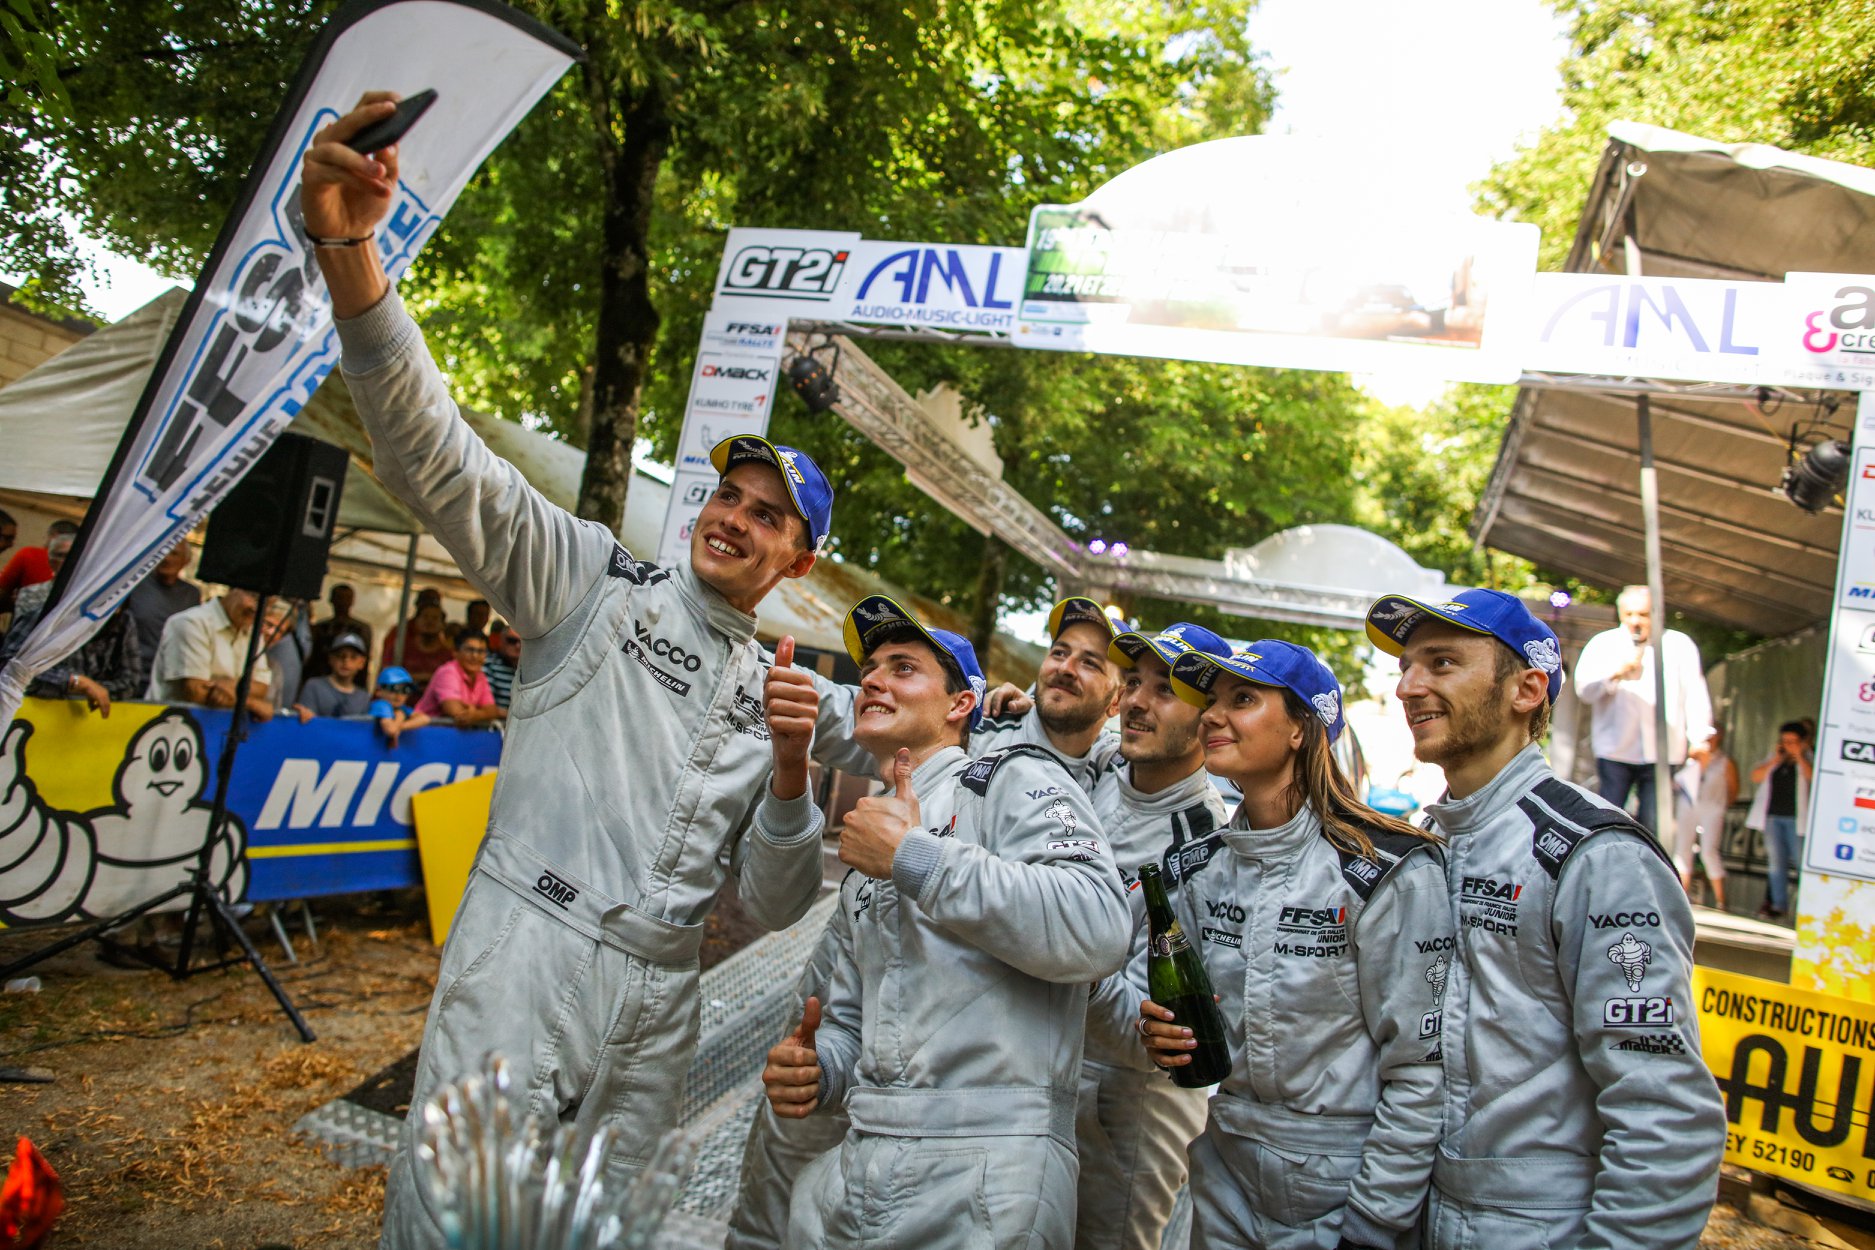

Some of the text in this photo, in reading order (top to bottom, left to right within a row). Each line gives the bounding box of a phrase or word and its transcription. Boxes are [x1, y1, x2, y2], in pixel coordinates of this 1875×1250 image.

[856, 248, 1013, 309] AML
[851, 304, 1014, 328] AUDIO-MUSIC-LIGHT
[1539, 283, 1759, 355] AML
[635, 619, 701, 672] YACCO
[641, 656, 686, 692] MICHELIN
[967, 763, 992, 779] OMP
[1539, 832, 1568, 857] OMP
[1181, 847, 1209, 869] OMP
[1348, 858, 1379, 881] OMP
[537, 874, 576, 904] OMP
[1461, 876, 1513, 902] FFSA
[1278, 907, 1338, 926] FFSA
[1461, 915, 1518, 937] M-SPORT
[1485, 908, 1517, 922] JUNIOR
[1588, 911, 1661, 929] YACCO
[1273, 942, 1349, 958] M-SPORT
[1604, 997, 1674, 1024] GT2i
[1752, 1138, 1815, 1172] 52190
